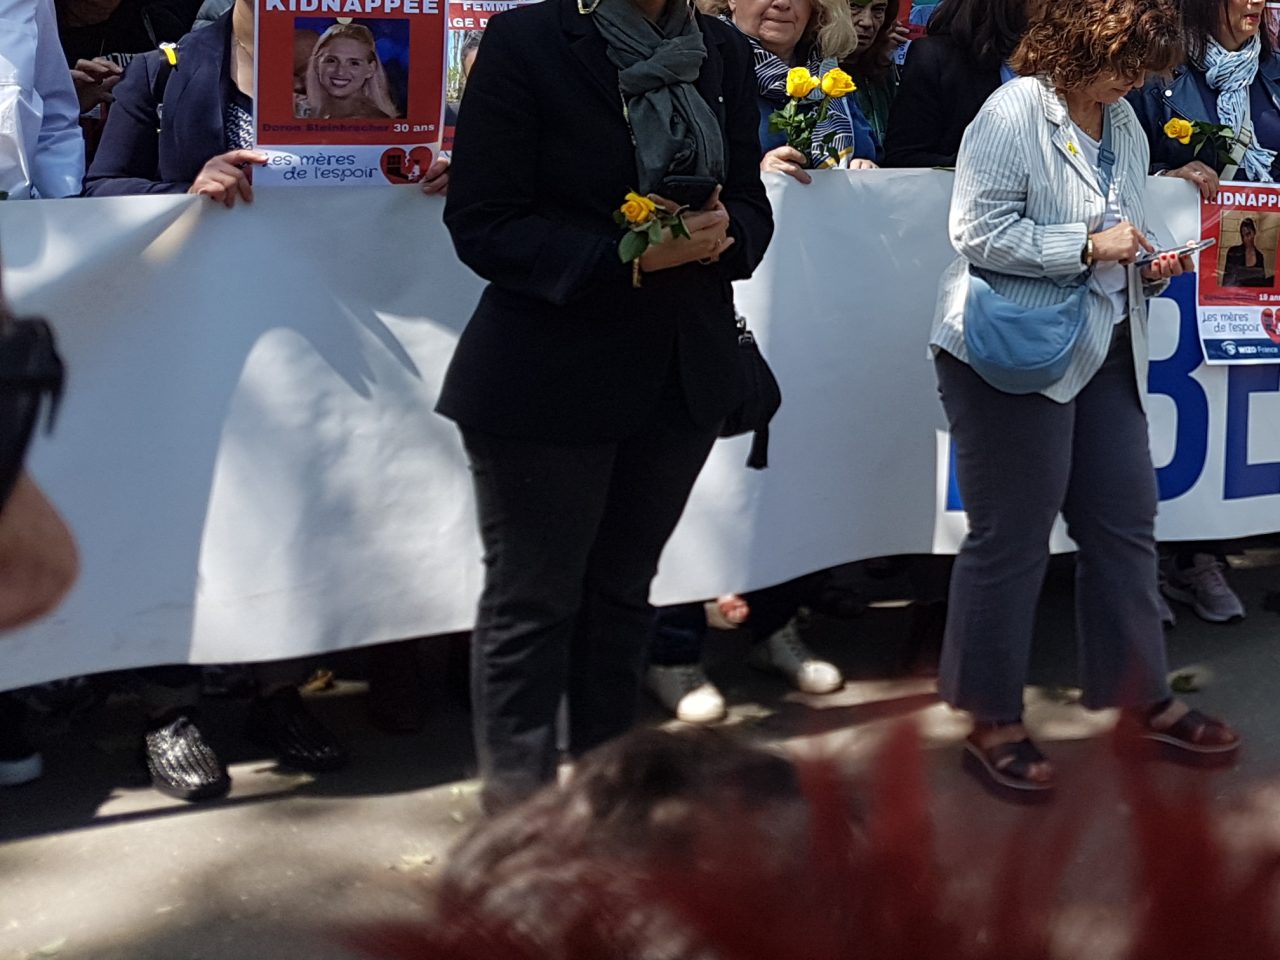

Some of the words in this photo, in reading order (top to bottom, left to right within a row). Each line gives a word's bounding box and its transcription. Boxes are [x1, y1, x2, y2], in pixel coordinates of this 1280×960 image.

[393, 123, 409, 132] 30
[412, 123, 435, 132] ans
[300, 152, 356, 166] mères
[283, 167, 307, 180] de
[314, 167, 378, 182] l'espoir
[1203, 312, 1217, 323] Les
[1220, 312, 1249, 322] mères
[1213, 322, 1226, 333] de
[1229, 323, 1261, 335] l'espoir
